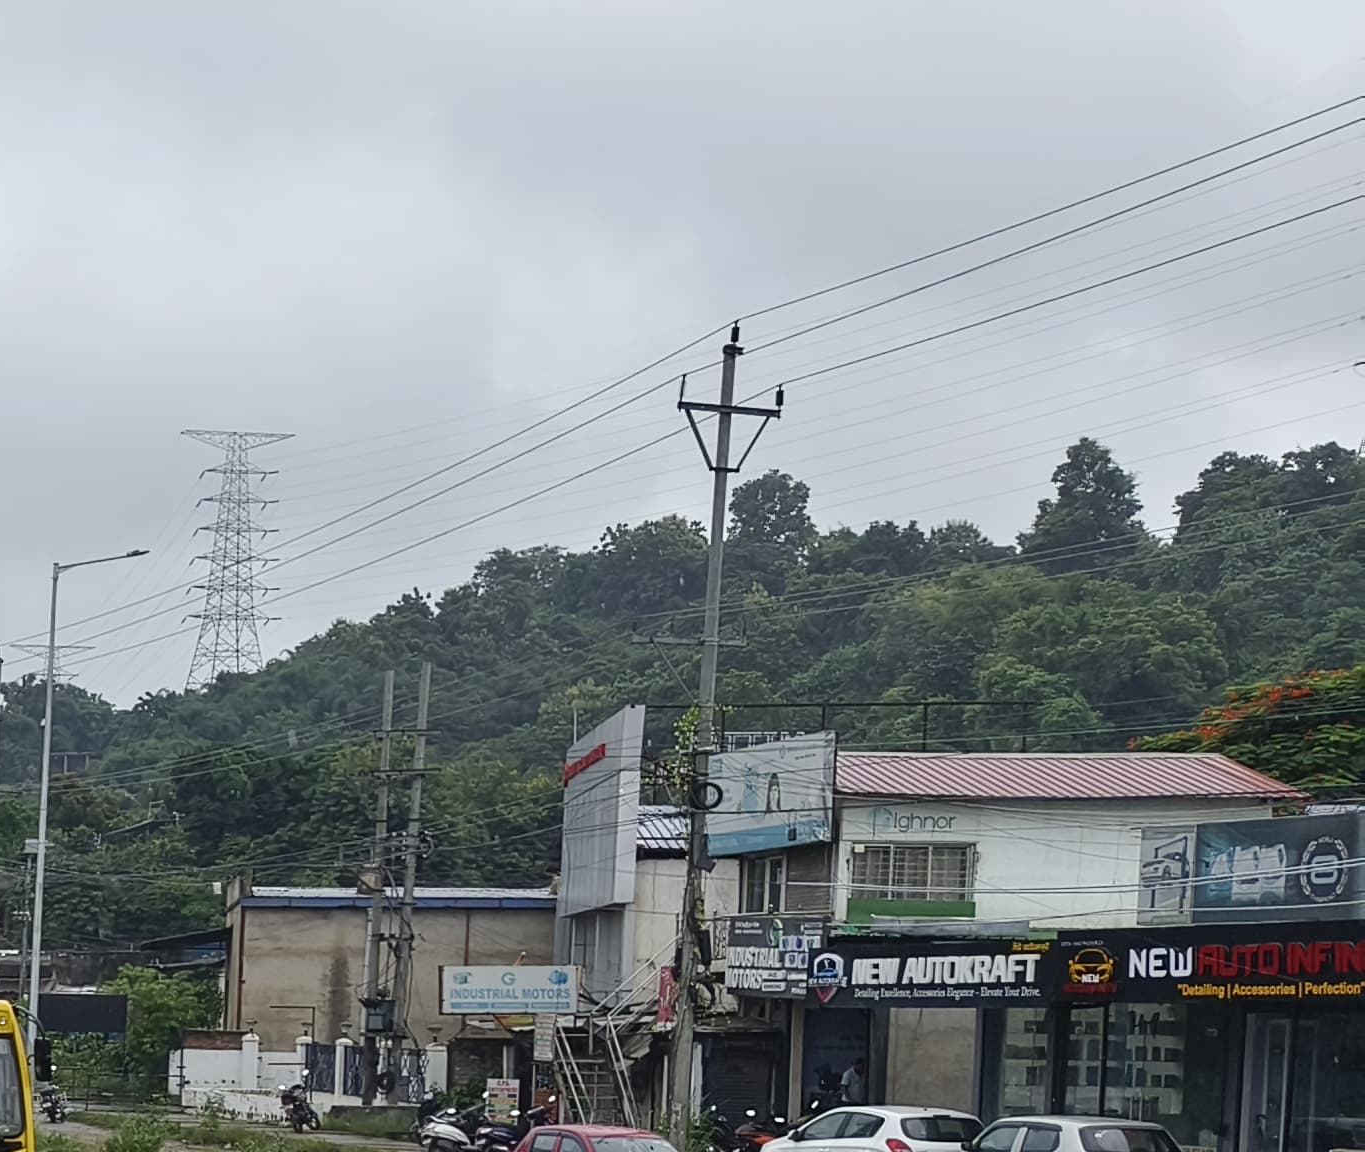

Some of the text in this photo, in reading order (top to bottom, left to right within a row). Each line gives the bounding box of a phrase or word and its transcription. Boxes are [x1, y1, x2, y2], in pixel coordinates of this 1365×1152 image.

[851, 953, 1041, 985] NEW AUTOKRAFT
[1128, 946, 1193, 978] NEW
[1198, 943, 1281, 977] AUTO
[450, 987, 570, 1000] INDUSTRIAL MOTORS
[1232, 982, 1296, 995] Accessories
